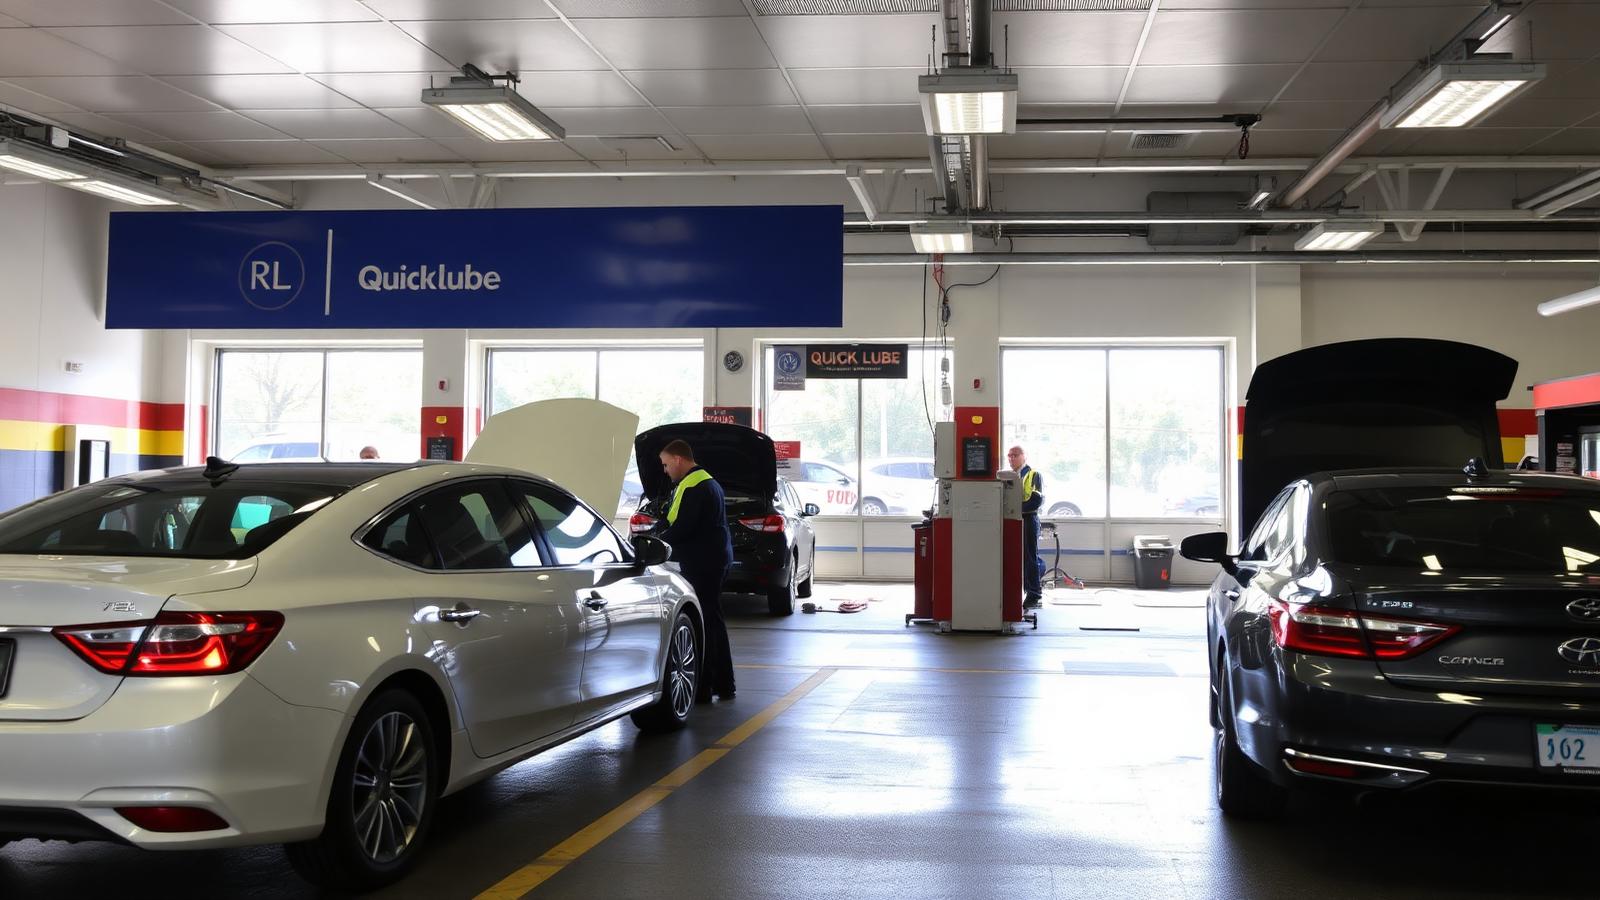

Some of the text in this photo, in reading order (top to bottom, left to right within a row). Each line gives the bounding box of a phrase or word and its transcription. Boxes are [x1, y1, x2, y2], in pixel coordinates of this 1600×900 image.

[251, 261, 291, 290] RL
[358, 264, 501, 292] Quicklube
[810, 351, 901, 366] QUICK LUBE
